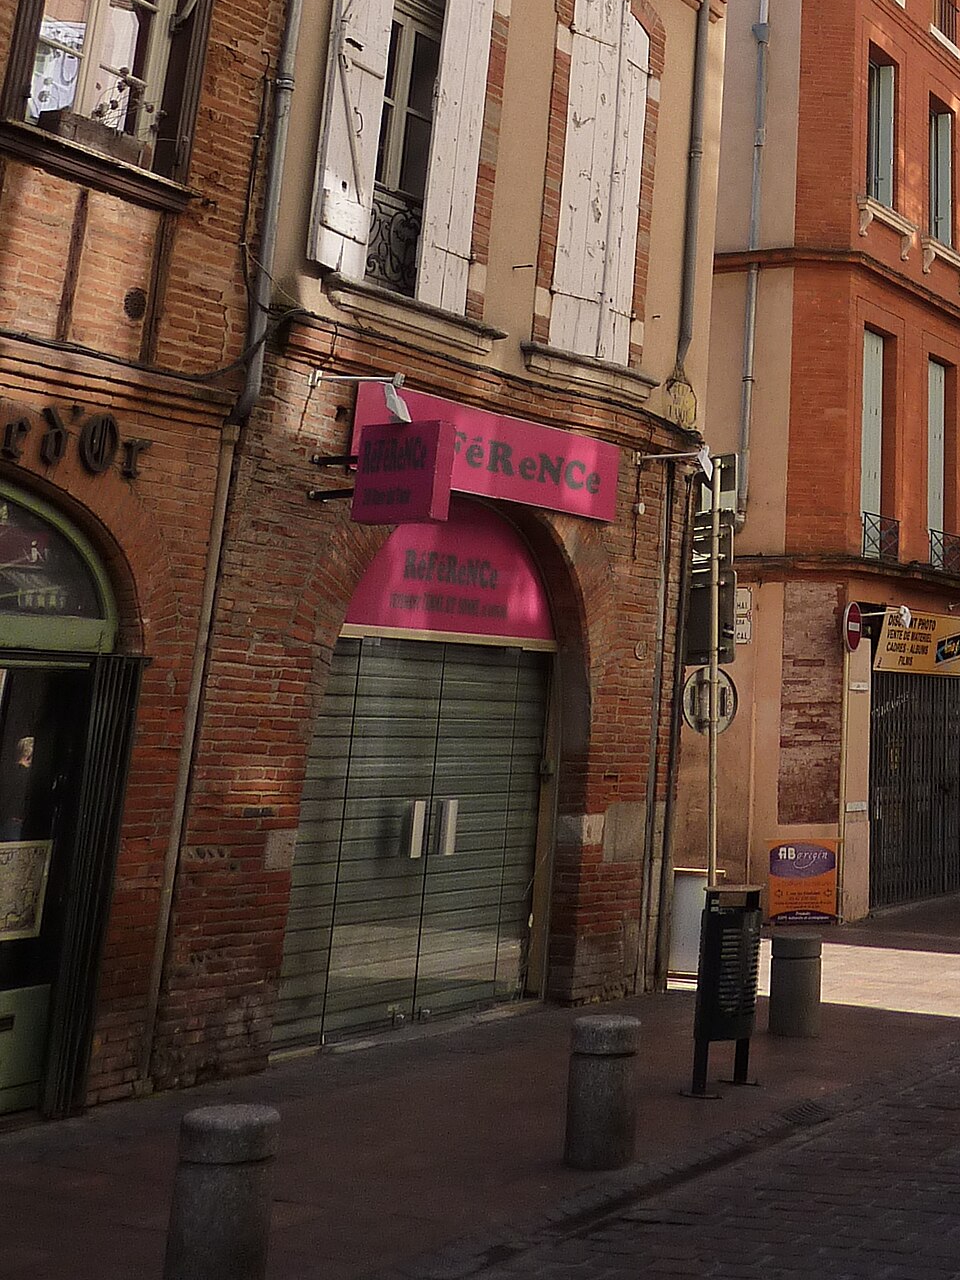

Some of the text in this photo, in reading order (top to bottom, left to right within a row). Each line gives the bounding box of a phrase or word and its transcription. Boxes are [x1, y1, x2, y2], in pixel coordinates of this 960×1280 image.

[888, 614, 936, 631] DISCNT PHOTO
[887, 629, 903, 640] VENTE
[903, 630, 911, 641] DE
[886, 642, 906, 653] CADRES
[910, 644, 929, 655] ALBUMS
[898, 656, 913, 666] FILMS
